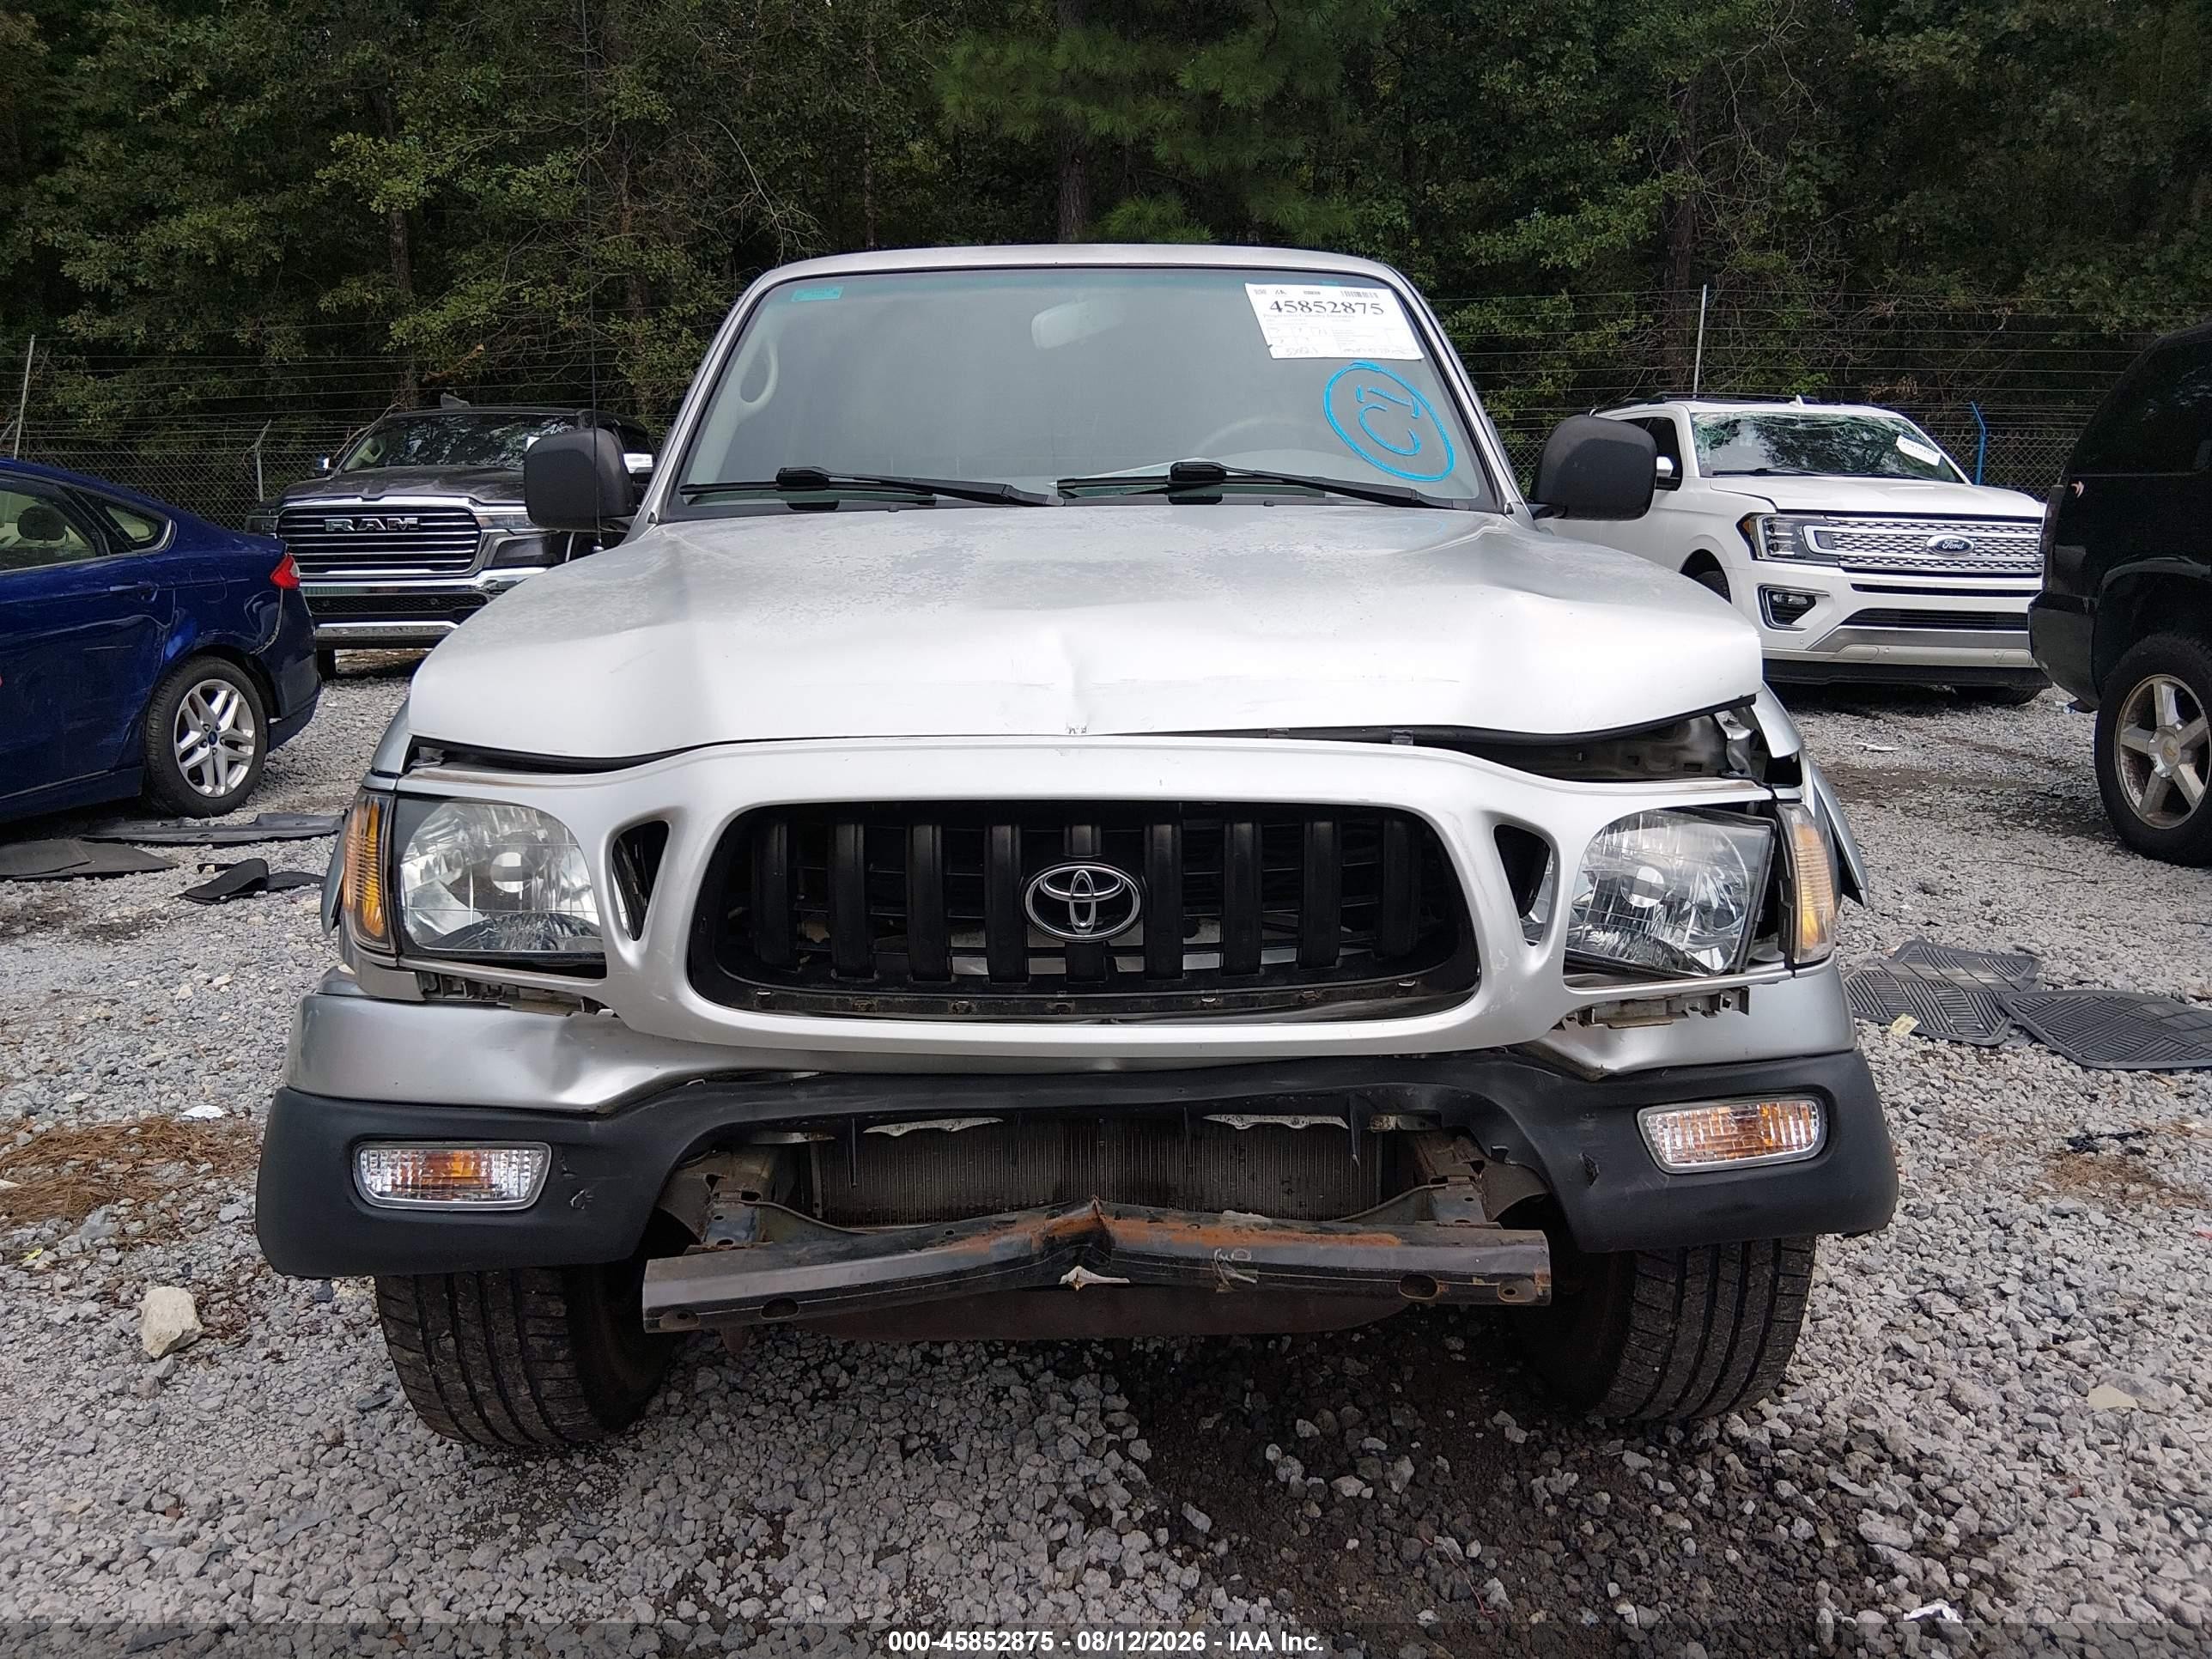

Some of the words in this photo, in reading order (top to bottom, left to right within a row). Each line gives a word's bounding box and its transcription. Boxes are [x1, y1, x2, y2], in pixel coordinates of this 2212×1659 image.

[1269, 300, 1384, 316] 45852875
[324, 517, 419, 532] RAM
[1942, 539, 1966, 550] Ford
